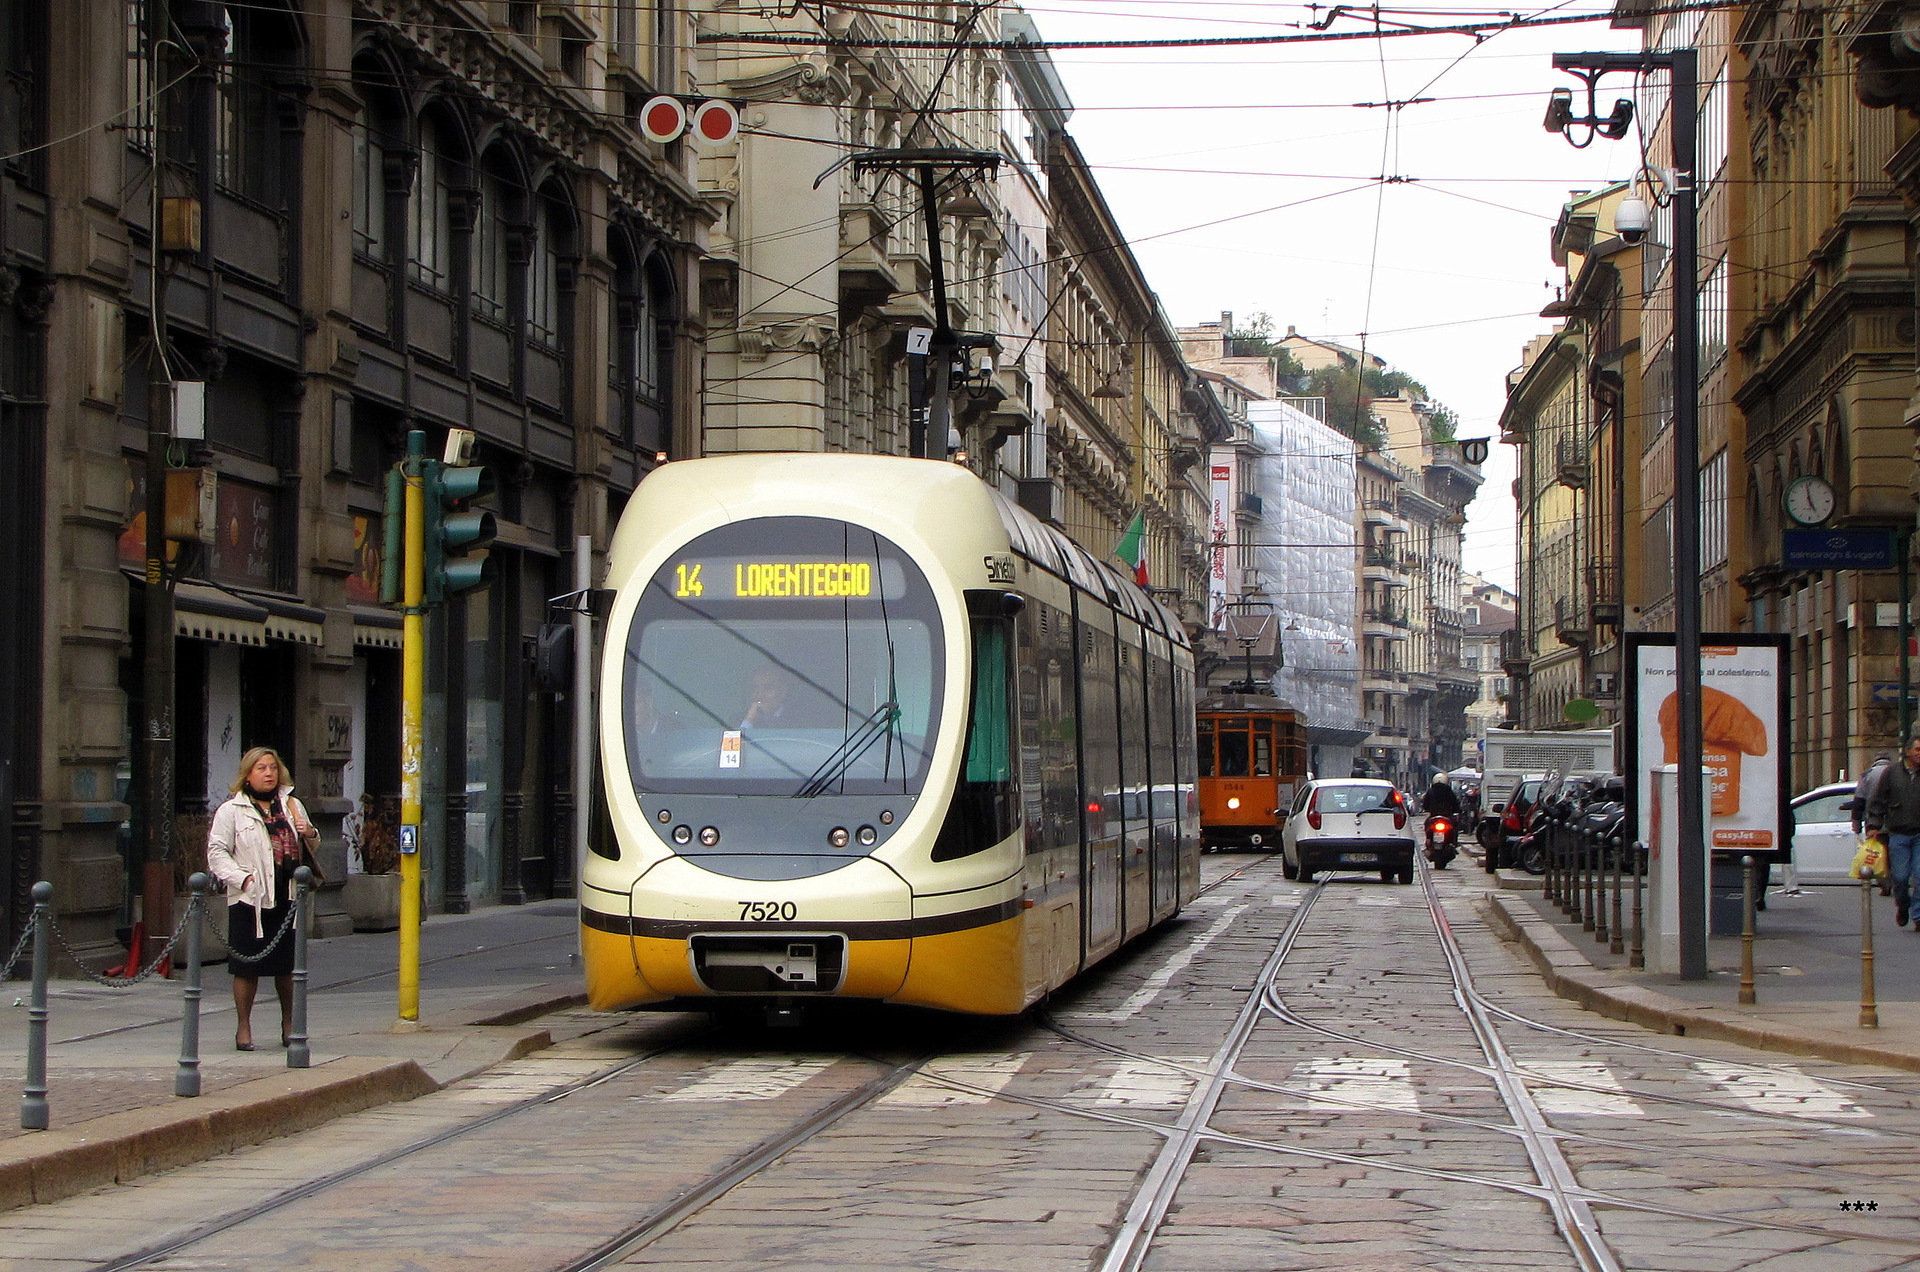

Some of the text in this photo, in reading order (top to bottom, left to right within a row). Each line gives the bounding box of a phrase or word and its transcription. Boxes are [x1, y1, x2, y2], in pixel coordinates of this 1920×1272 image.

[916, 334, 928, 347] 7
[676, 563, 871, 597] 14 LORENTEGGIO
[1645, 667, 1664, 675] Non
[726, 754, 737, 764] 14
[737, 901, 797, 921] 7520
